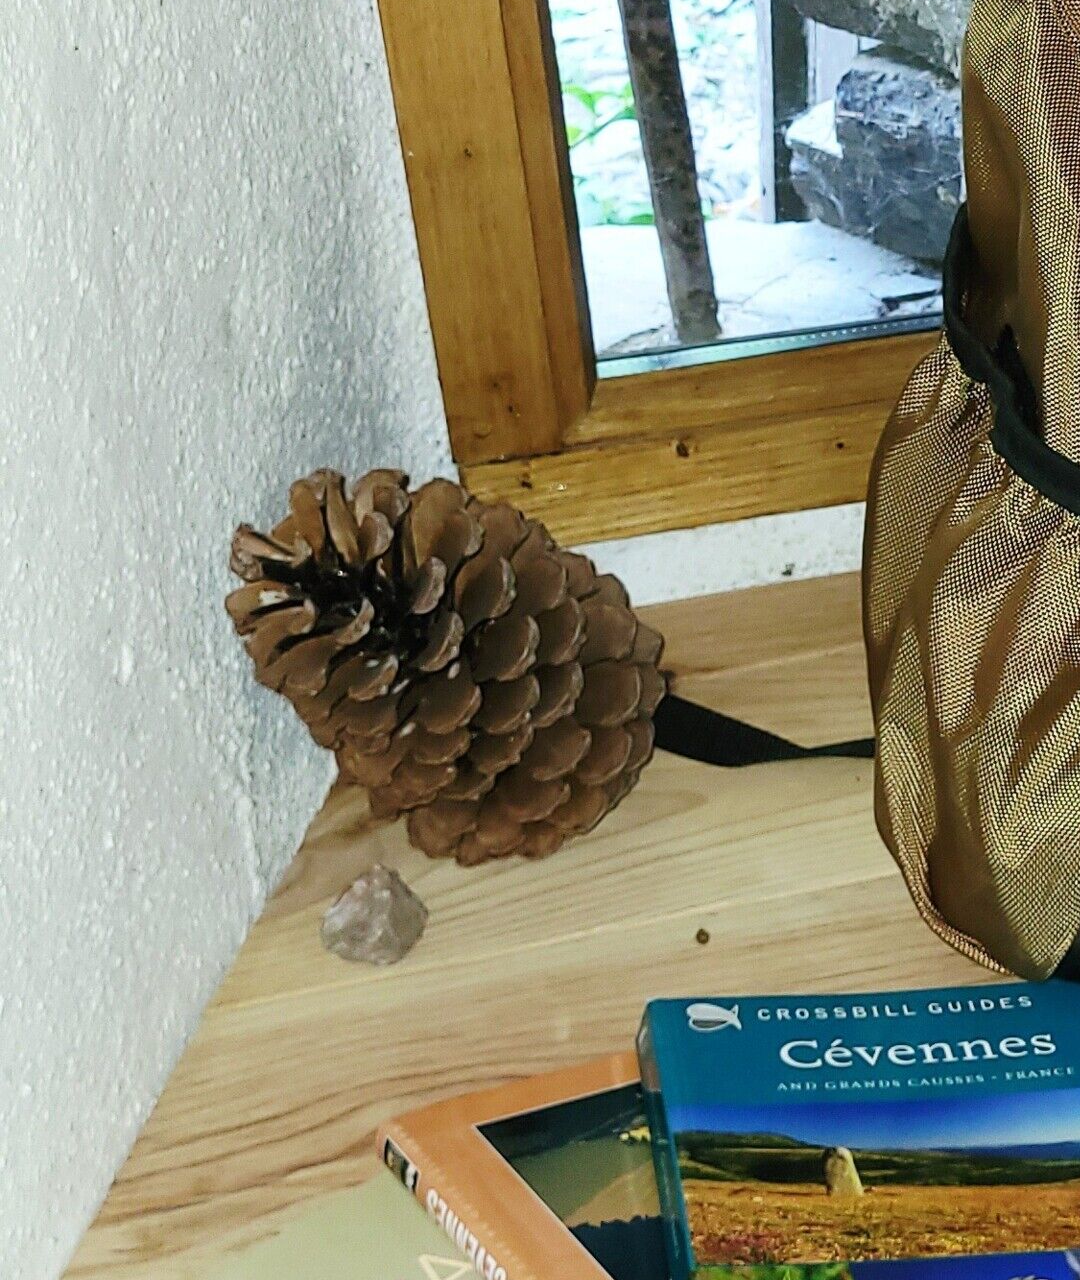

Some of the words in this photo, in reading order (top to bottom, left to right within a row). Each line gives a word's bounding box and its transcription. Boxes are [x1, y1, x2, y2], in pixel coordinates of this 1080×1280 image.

[757, 1002, 916, 1022] CROSSBILL
[929, 995, 1033, 1016] GUIDES
[779, 1031, 1057, 1069] Cévennes
[777, 1080, 816, 1091] AND
[825, 1079, 900, 1090] GRANDS
[907, 1073, 984, 1087] CAUSSES
[1005, 1067, 1075, 1081] FRANCE
